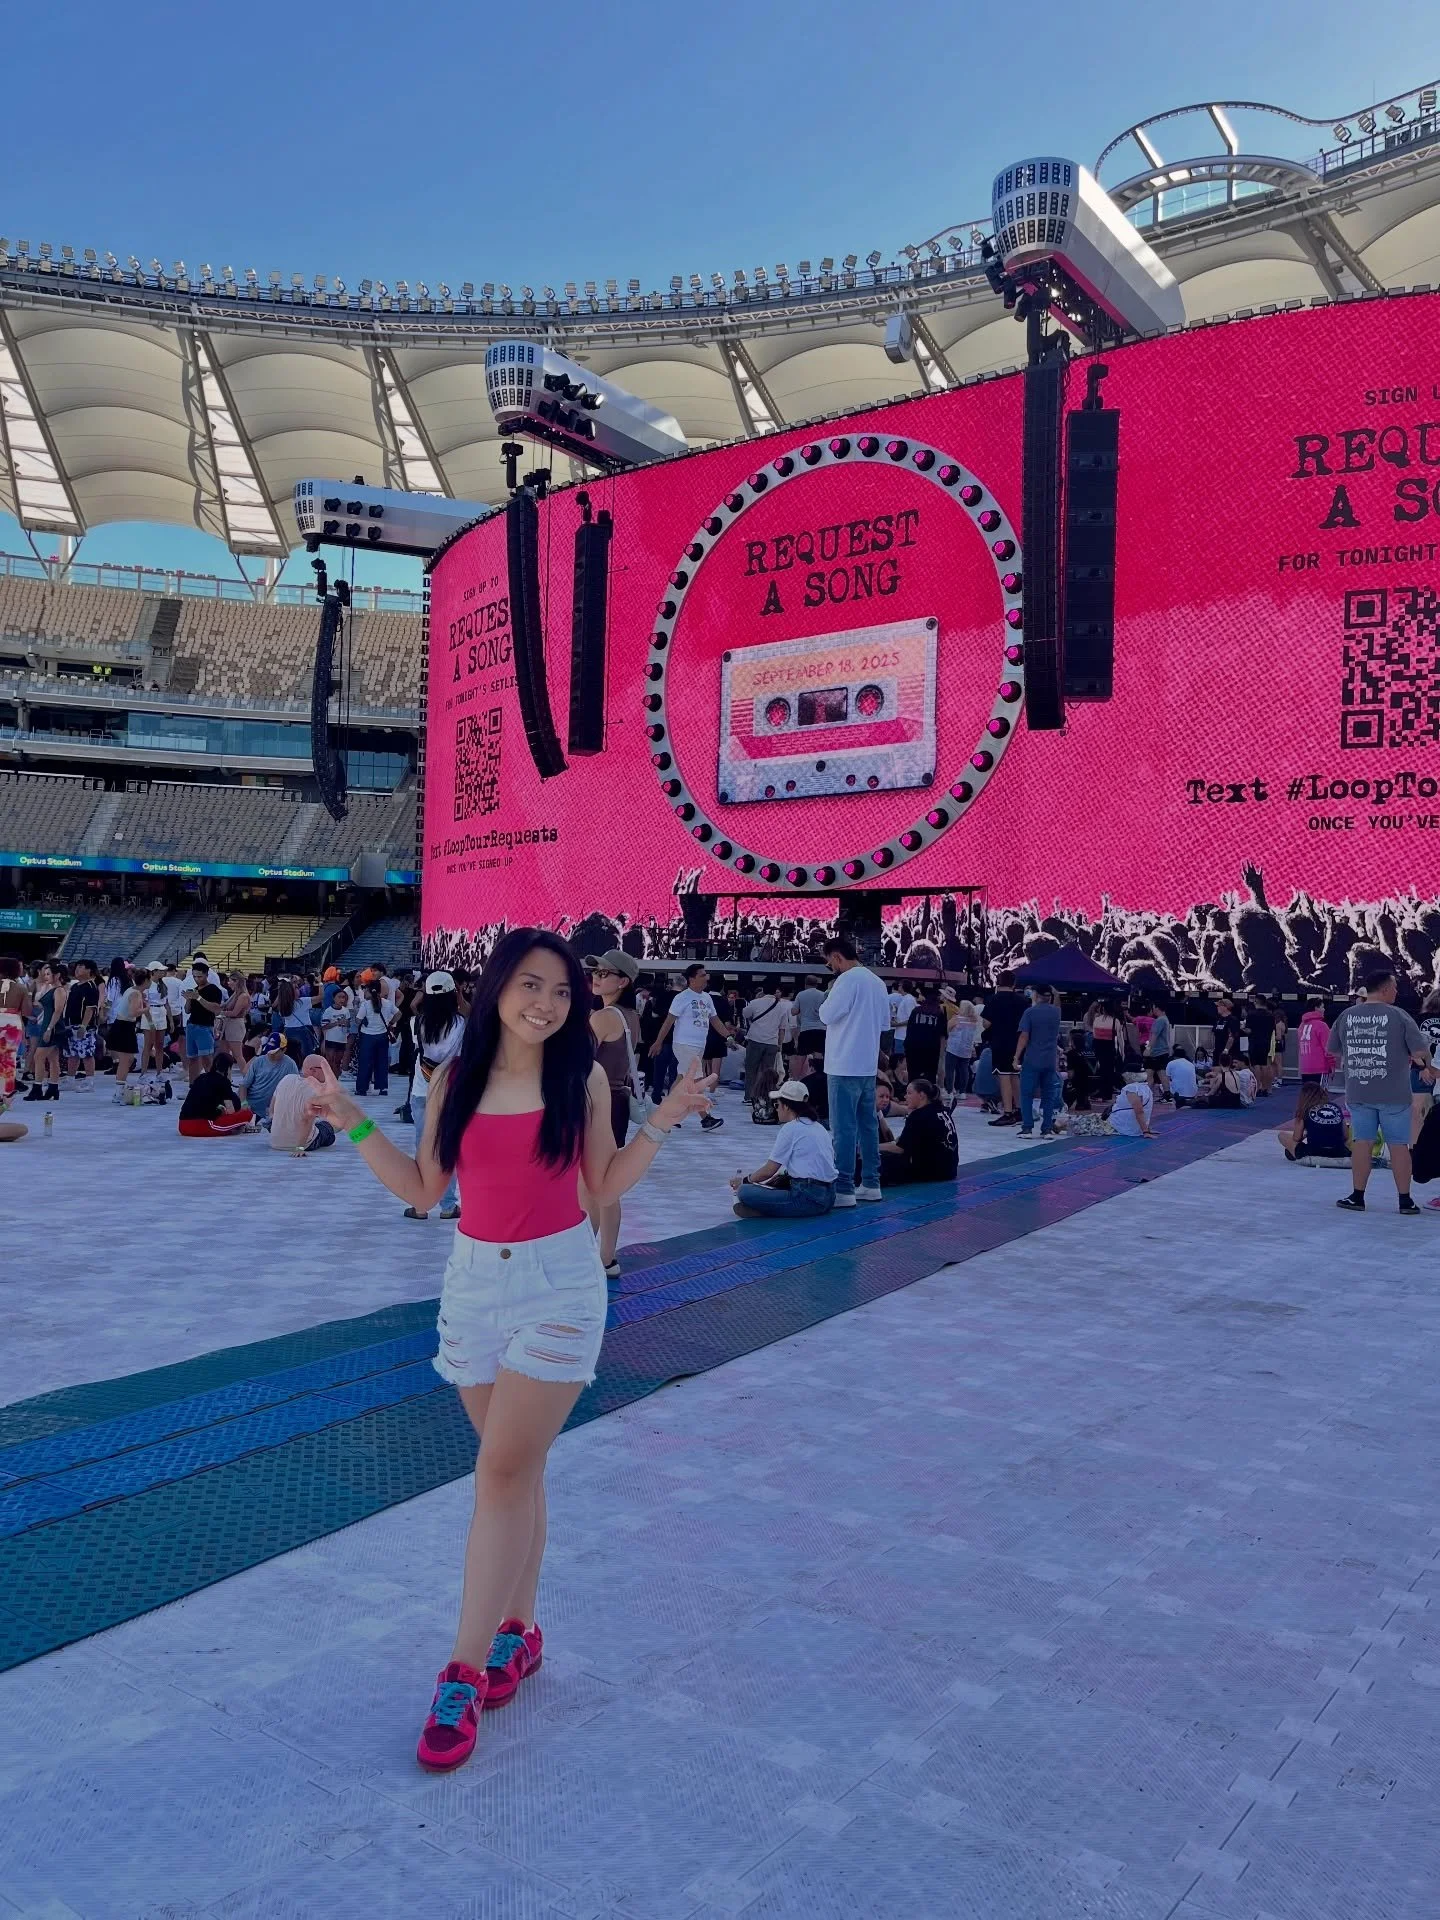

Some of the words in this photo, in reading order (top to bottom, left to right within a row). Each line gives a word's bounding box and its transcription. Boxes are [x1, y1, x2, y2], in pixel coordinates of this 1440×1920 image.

[1364, 385, 1418, 406] SIGN
[1318, 484, 1361, 529] A
[1393, 477, 1440, 523] S
[743, 508, 920, 577] REQUEST
[1278, 553, 1320, 573] FOR
[1336, 544, 1439, 567] TONIGHT
[463, 587, 476, 602] SIGN
[478, 580, 487, 594] UP
[490, 575, 499, 588] TO
[759, 579, 785, 616] A
[803, 557, 903, 608] SONG
[448, 596, 509, 653] REQUES
[452, 653, 461, 683] A
[467, 632, 512, 675] SONG
[752, 661, 834, 686] SEPTEMBER
[861, 651, 900, 671] 2025
[1186, 776, 1269, 805] Text
[1287, 771, 1439, 805] #LoopTo
[1308, 815, 1355, 831] ONCE
[1368, 814, 1440, 830] YOU'VE
[443, 824, 558, 857] #LoopTourRequests
[19, 856, 47, 866] Optus
[46, 857, 82, 867] Stadium
[142, 862, 168, 872] Optus
[168, 863, 202, 873] Stadium
[258, 867, 282, 877] Optus
[282, 868, 315, 878] Stadium
[478, 857, 500, 870] SIGNED
[504, 856, 513, 867] UP
